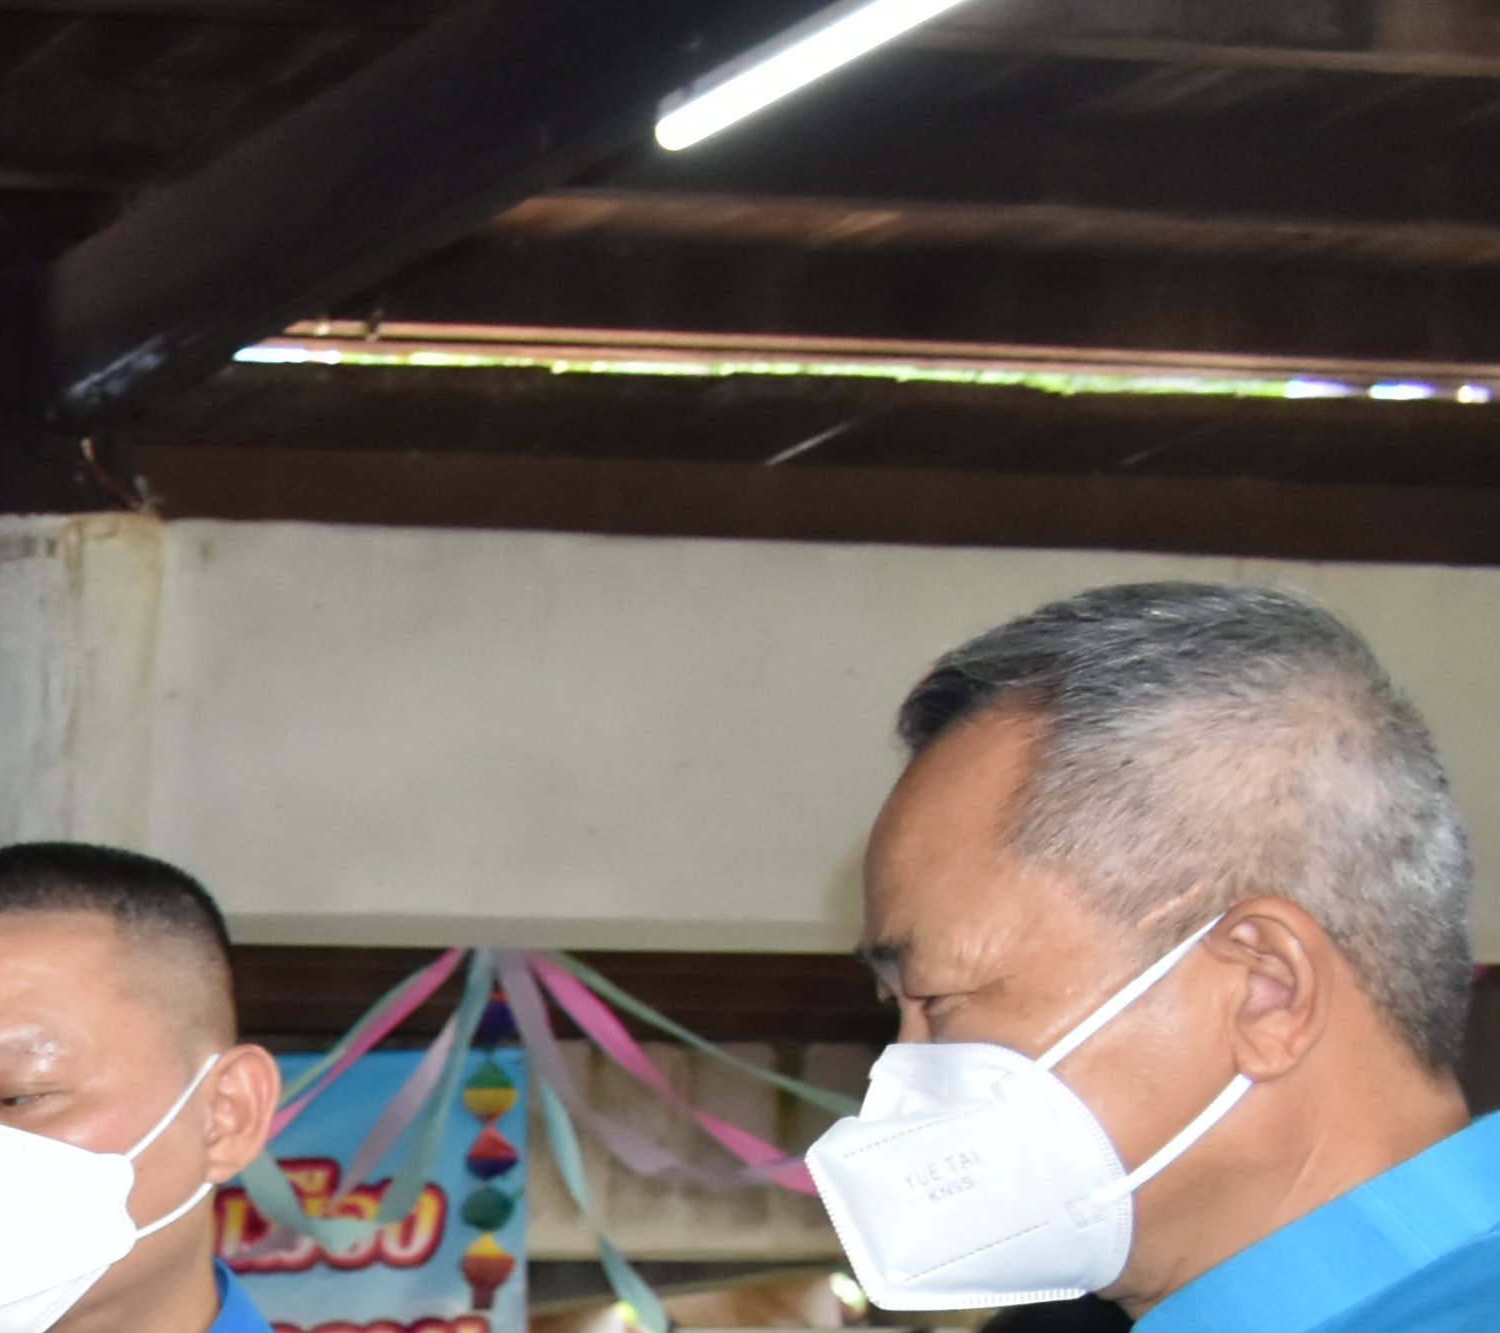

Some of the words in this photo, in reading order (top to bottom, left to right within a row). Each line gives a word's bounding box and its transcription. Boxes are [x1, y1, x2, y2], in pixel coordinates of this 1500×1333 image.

[902, 1162, 942, 1191] YUE
[944, 1148, 982, 1173] TAI
[926, 1176, 974, 1203] KN95
